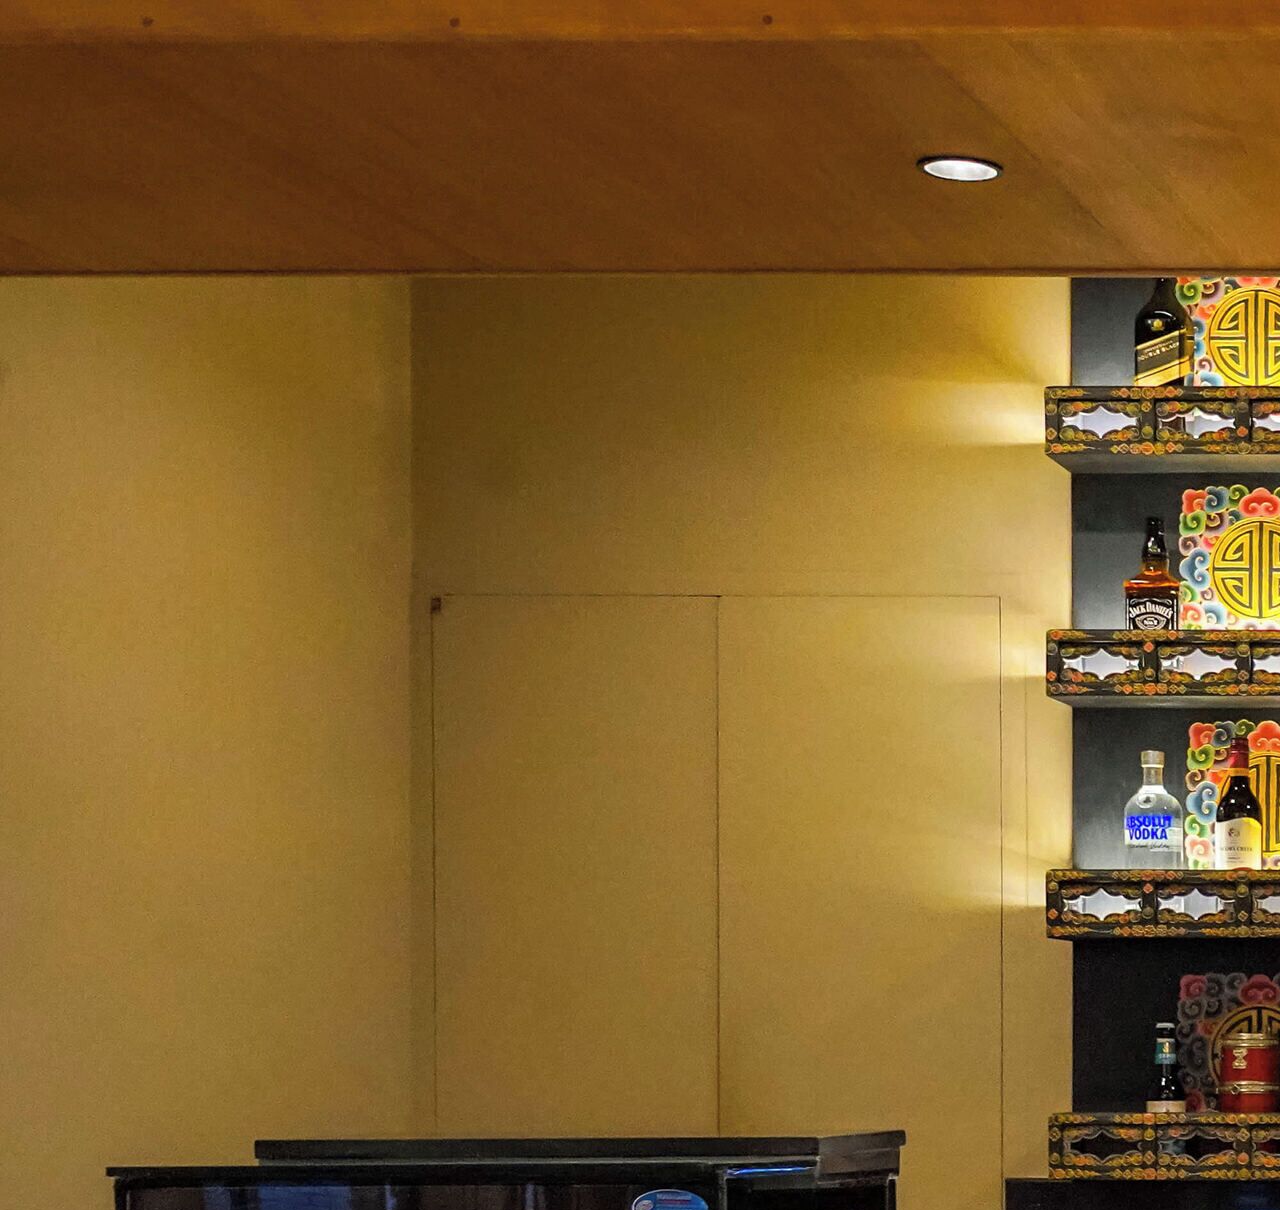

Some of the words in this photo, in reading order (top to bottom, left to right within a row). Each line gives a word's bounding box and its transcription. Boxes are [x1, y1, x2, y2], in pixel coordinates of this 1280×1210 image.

[1129, 604, 1146, 618] JACK
[1146, 602, 1173, 619] DANIEL'S
[1128, 828, 1168, 840] VODKA
